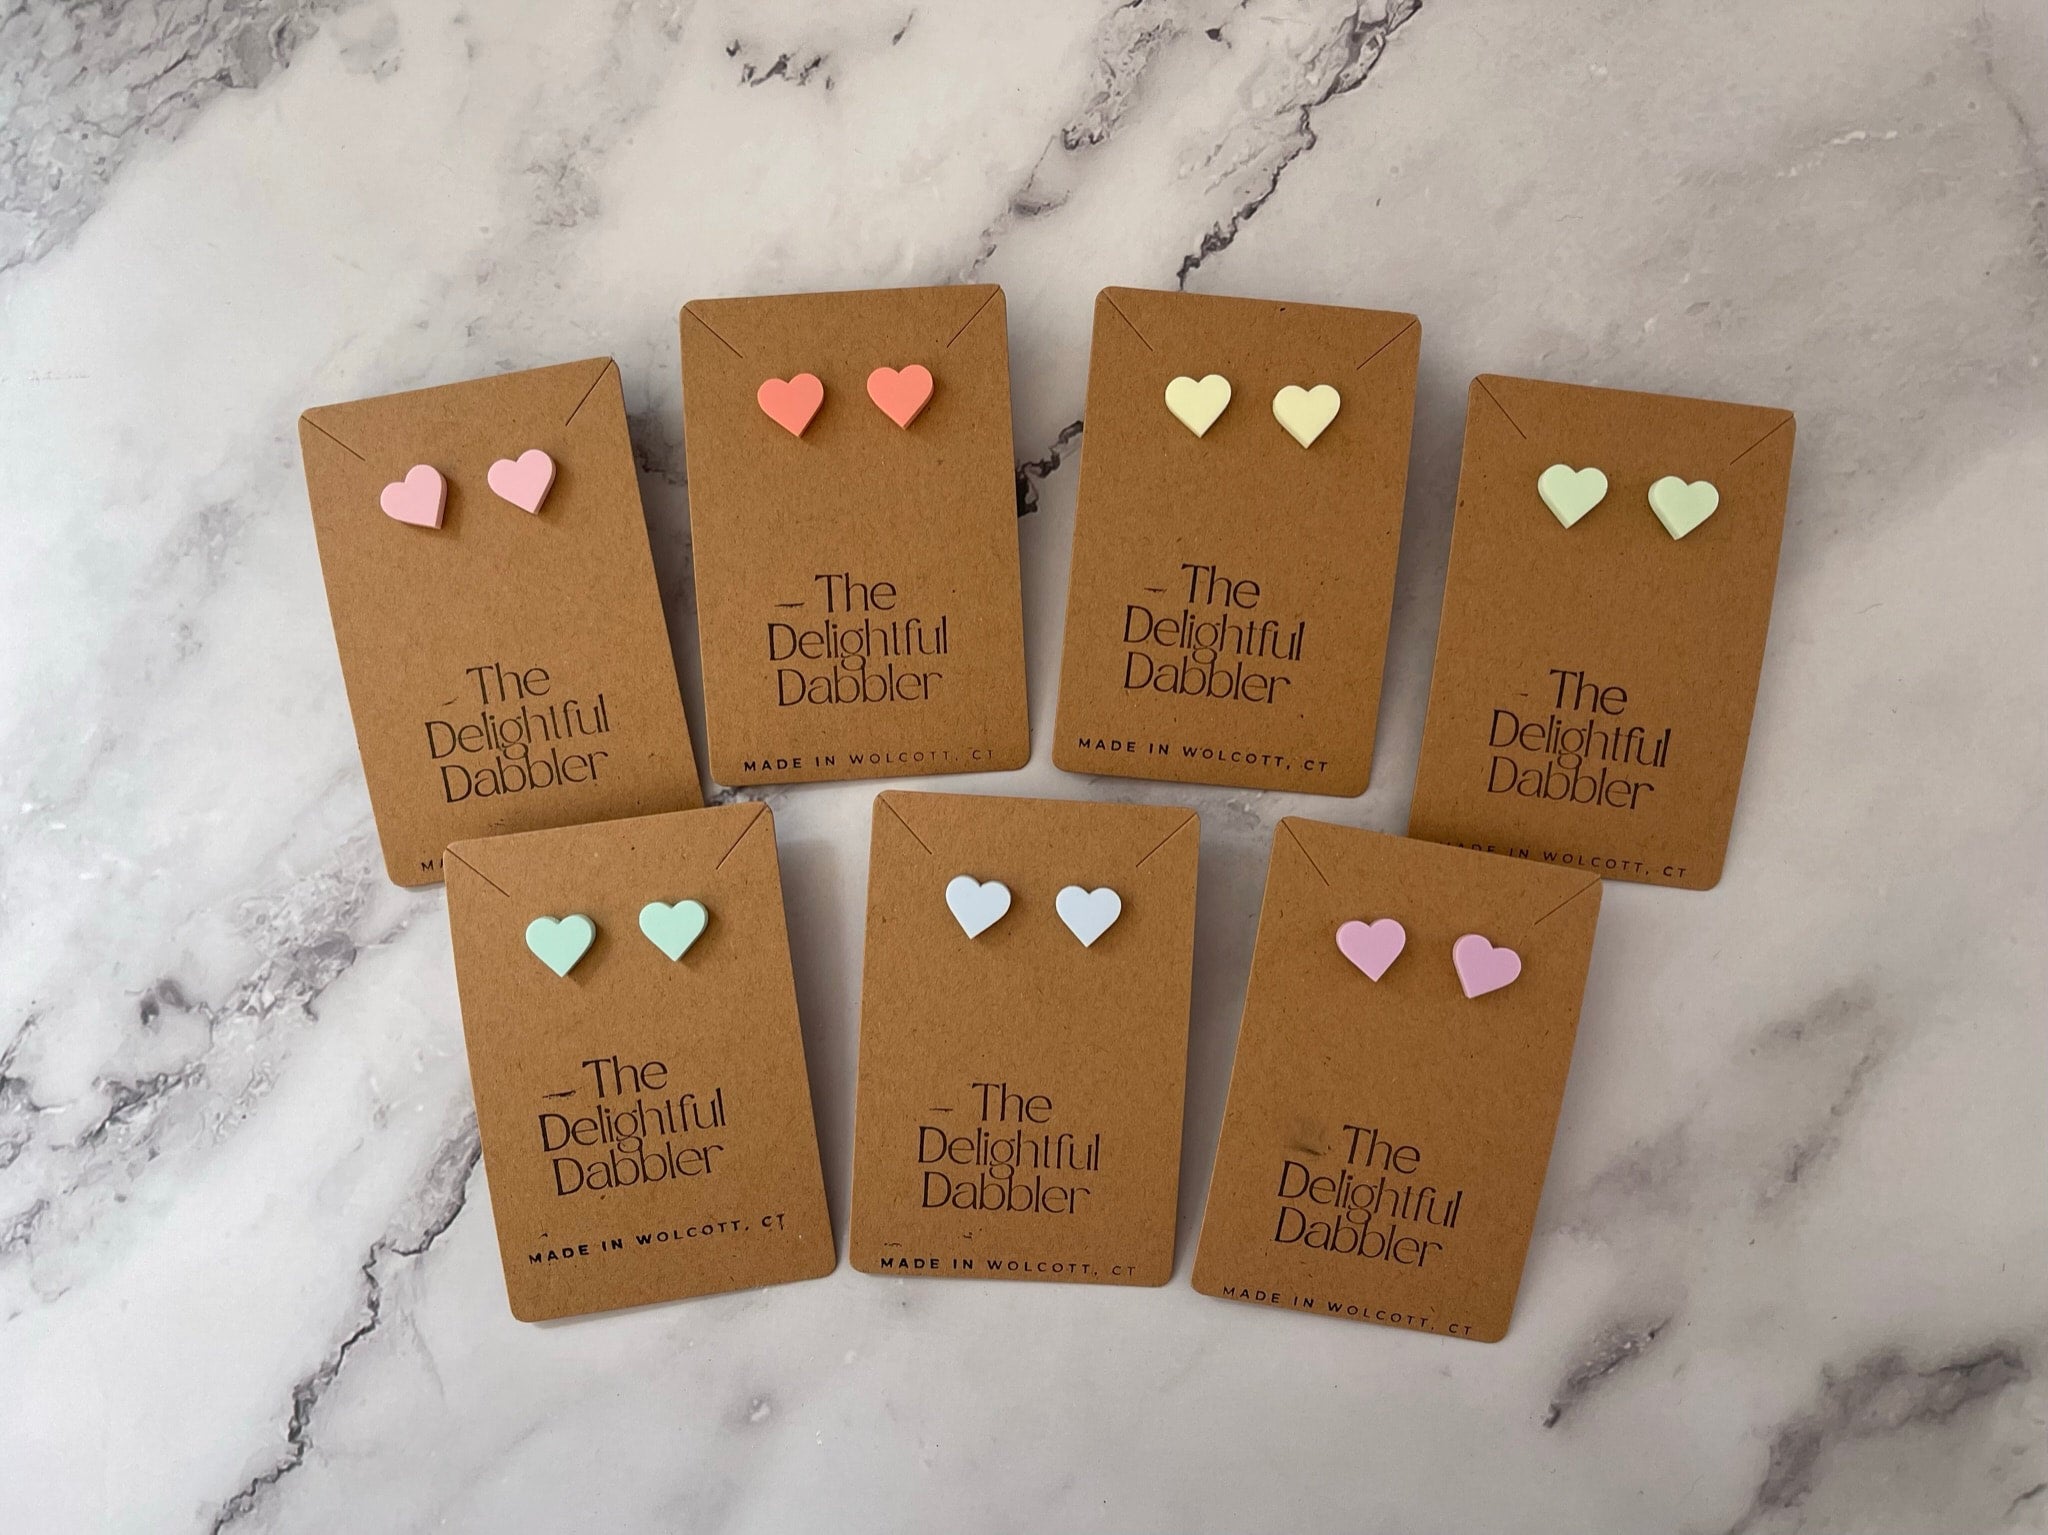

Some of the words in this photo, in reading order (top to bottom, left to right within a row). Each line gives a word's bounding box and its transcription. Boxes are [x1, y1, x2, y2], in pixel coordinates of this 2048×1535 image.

[815, 572, 896, 613] The
[1181, 563, 1260, 609] The
[768, 615, 948, 671] Delightful
[1123, 605, 1305, 664] Delightful
[466, 662, 550, 704] The
[777, 663, 942, 706] Dabbler
[1124, 652, 1291, 704] Dabbler
[1550, 669, 1627, 715] The
[425, 694, 610, 760] Delightful
[1489, 709, 1671, 769] Delightful
[440, 747, 608, 803] Dabbler
[744, 758, 802, 771] MADE
[816, 756, 835, 766] IN
[972, 750, 993, 760] CT
[1079, 738, 1136, 752] MADE
[1150, 744, 1169, 755] IN
[1183, 746, 1291, 770] WOLCOTT,
[1304, 760, 1328, 772] CT
[1487, 756, 1654, 809] Dabbler
[1509, 848, 1529, 858] IN
[1543, 851, 1649, 875] WOLCOTT,
[1663, 866, 1687, 877] CT
[582, 1056, 668, 1098] The
[538, 1088, 726, 1153] Delightful
[972, 1082, 1052, 1123] The
[552, 1141, 724, 1196] Dabbler
[918, 1126, 1100, 1179] Delightful
[1343, 1125, 1420, 1174] The
[922, 1171, 1090, 1214] Dabbler
[1278, 1160, 1462, 1228] Delightful
[529, 1245, 589, 1264] MADE
[602, 1239, 623, 1251] IN
[762, 1214, 785, 1230] CT
[1275, 1206, 1443, 1266] Dabbler
[881, 1258, 939, 1269] MADE
[953, 1259, 973, 1269] IN
[987, 1260, 1098, 1275] WOLCOTT,
[1112, 1266, 1135, 1276] CT
[1223, 1287, 1280, 1303] MADE
[1294, 1296, 1314, 1308] IN
[1328, 1302, 1434, 1330] WOLCOTT,
[1449, 1323, 1472, 1335] CT
